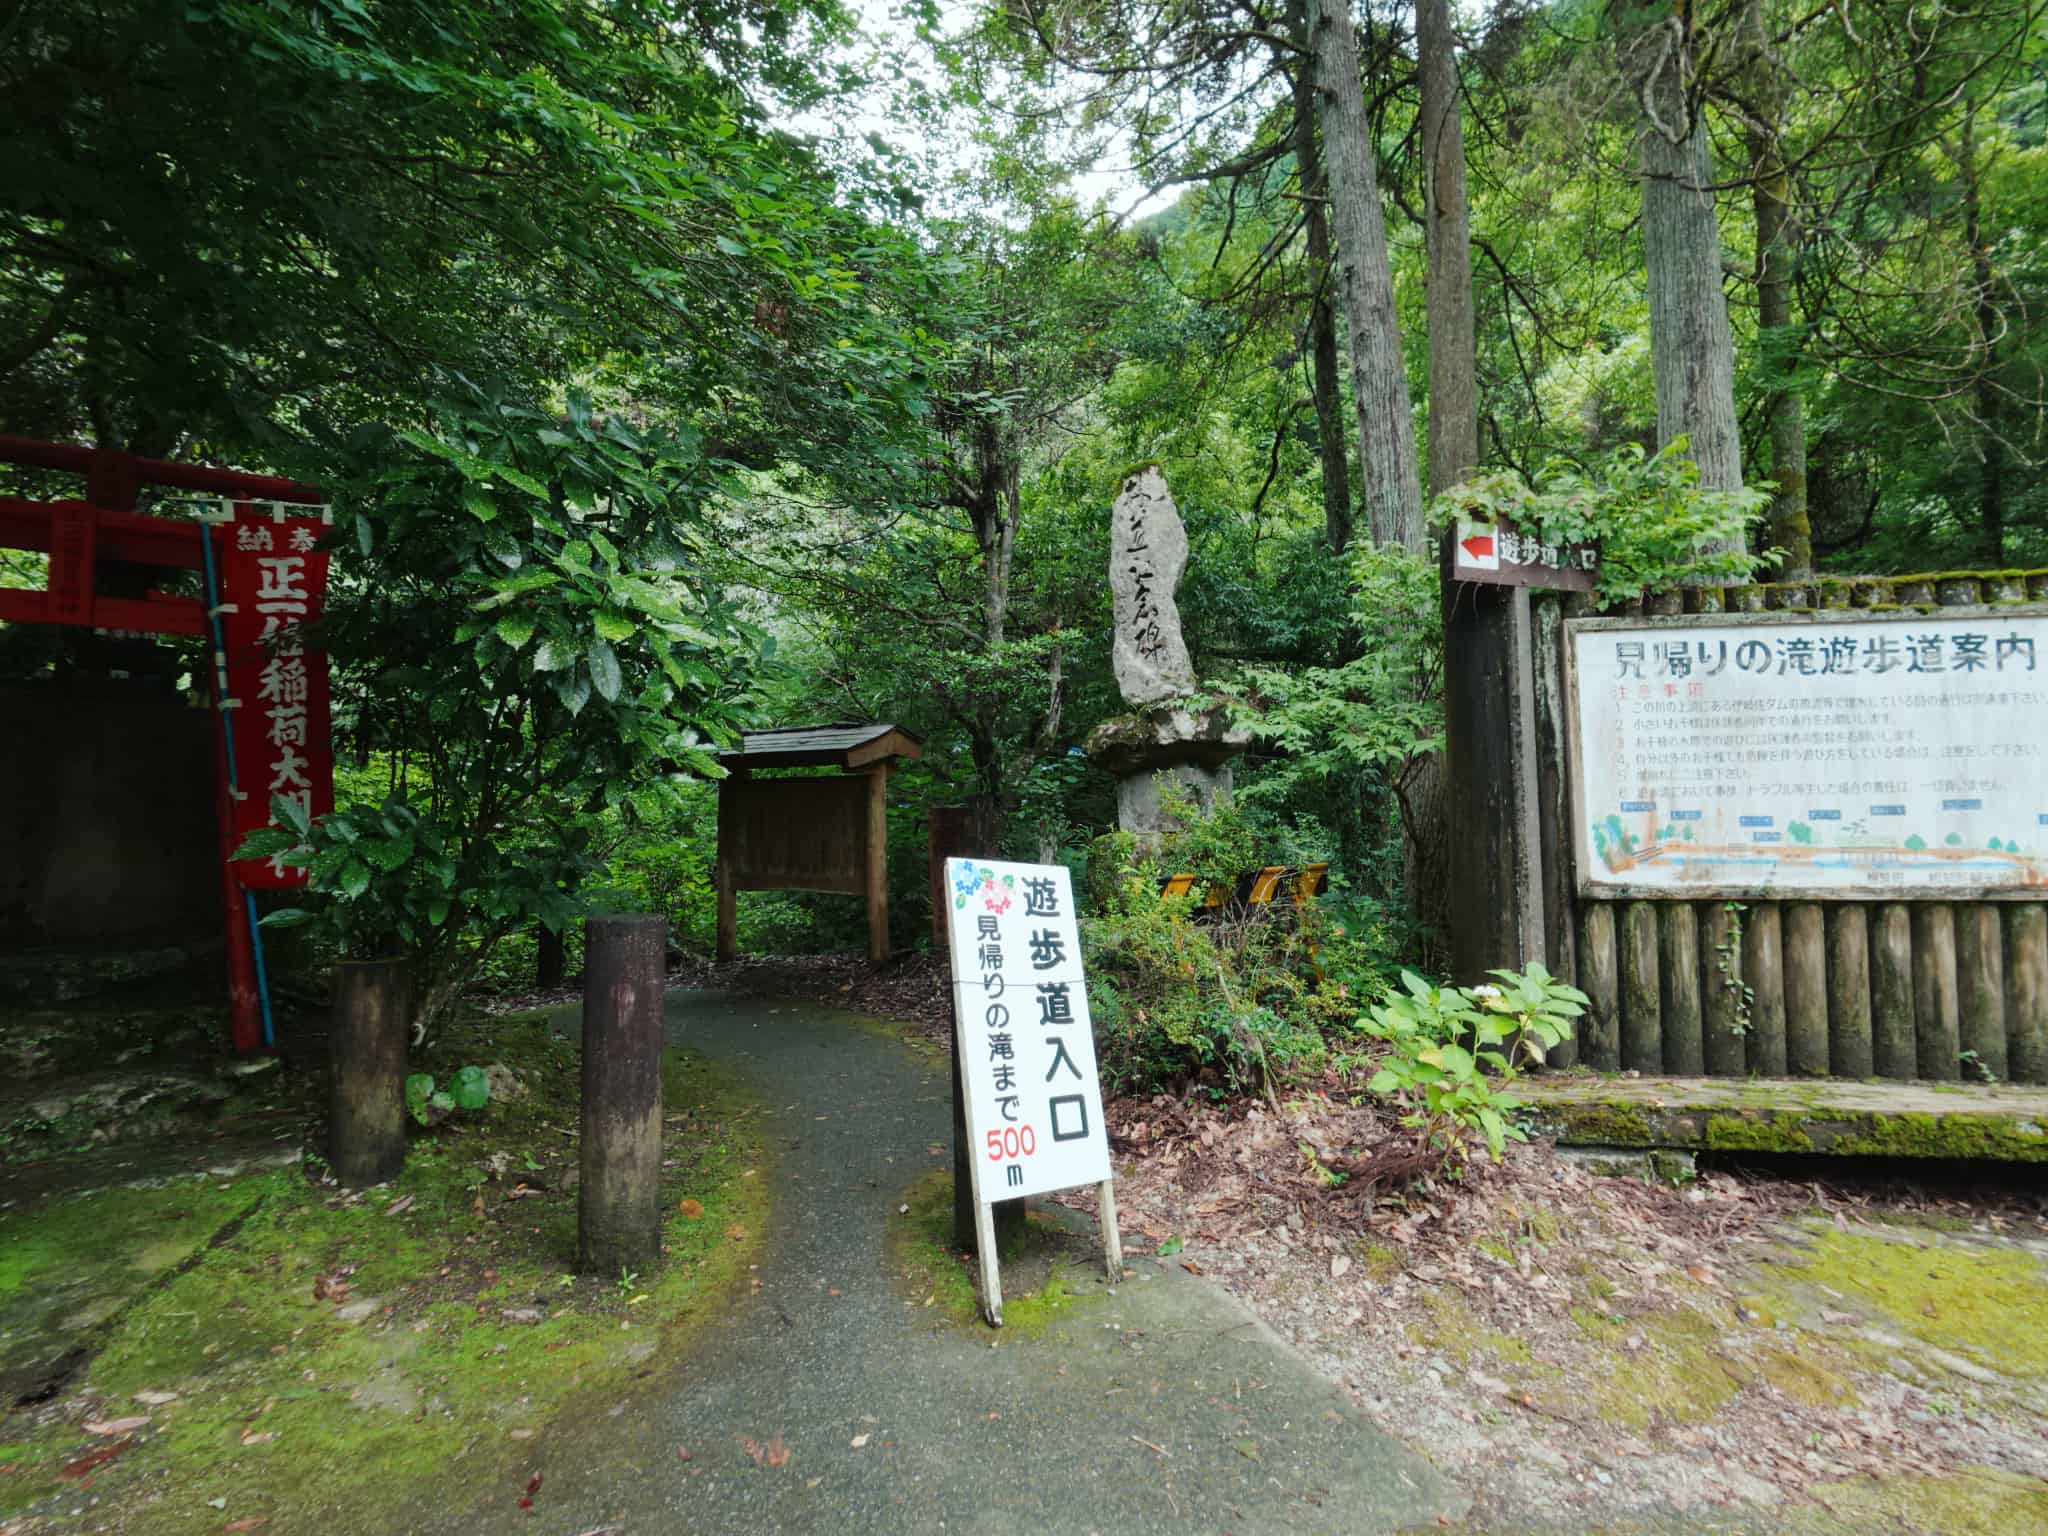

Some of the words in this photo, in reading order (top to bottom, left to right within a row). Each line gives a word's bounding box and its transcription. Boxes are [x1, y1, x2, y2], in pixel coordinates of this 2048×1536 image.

[1500, 531, 1597, 571] 遊歩道口
[255, 557, 314, 878] 正一位稲荷大
[1615, 632, 2036, 679] 見帰りの滝遊歩道案内
[976, 915, 1020, 1121] 見帰りの滝まで
[1022, 876, 1090, 1142] 遊歩道入口
